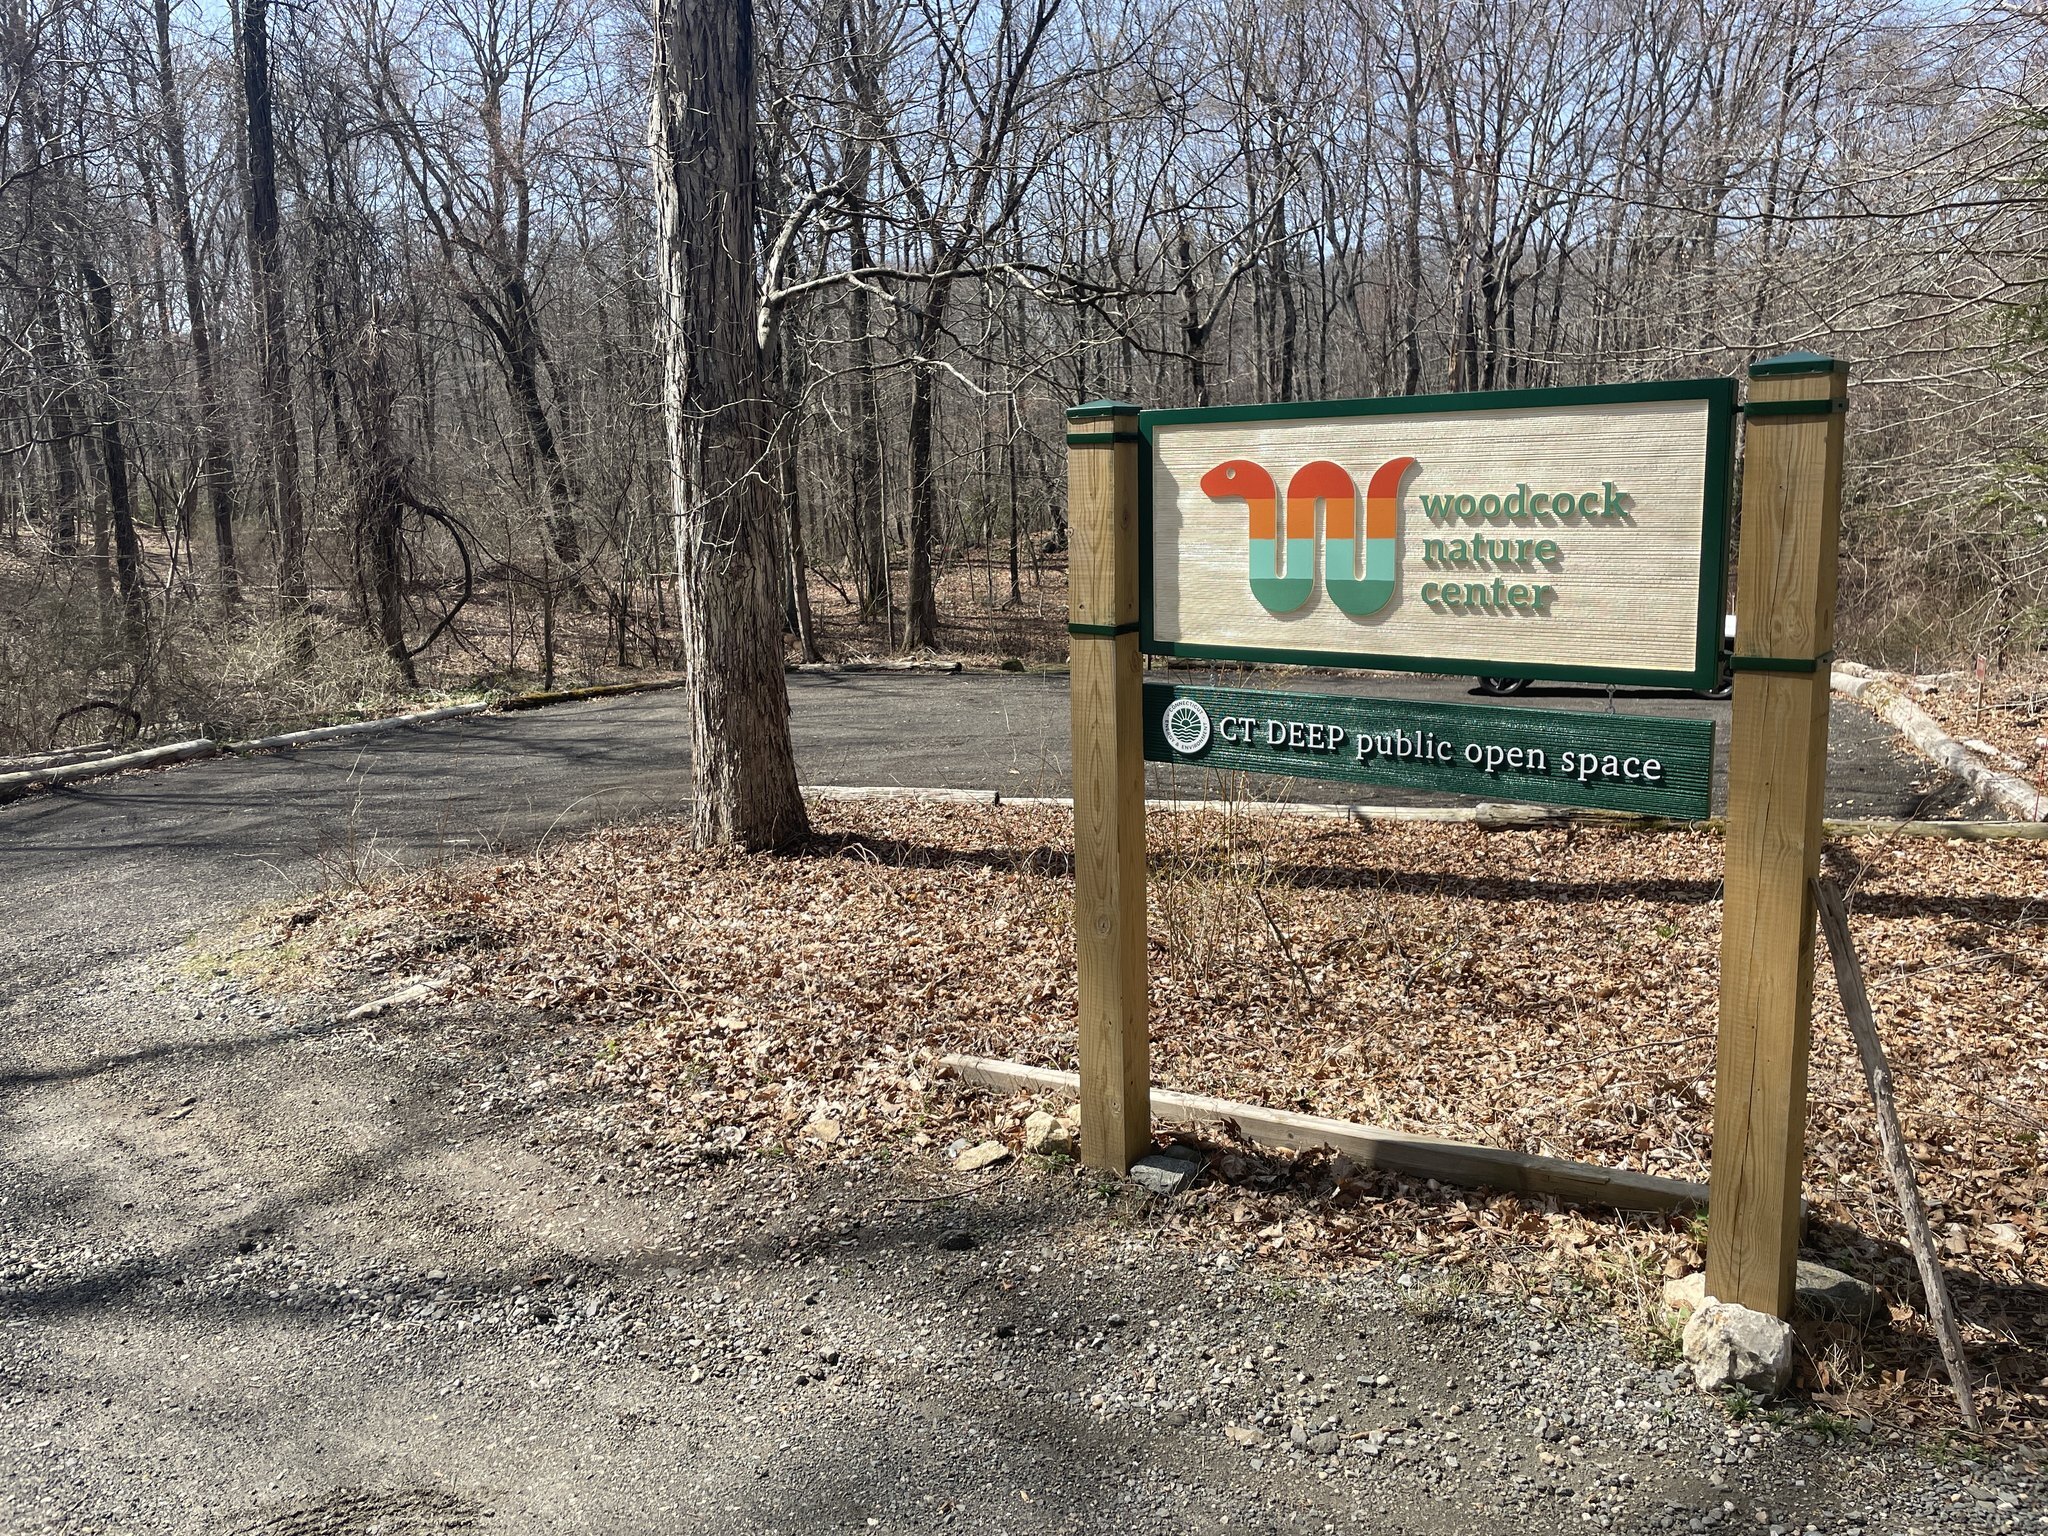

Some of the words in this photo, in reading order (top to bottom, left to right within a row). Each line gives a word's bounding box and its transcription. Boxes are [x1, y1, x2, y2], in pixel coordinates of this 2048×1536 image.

[1419, 481, 1629, 518] woodcock
[1422, 532, 1558, 563] nature
[1420, 577, 1550, 609] center
[1169, 701, 1203, 714] CONNECTICUT
[1219, 716, 1256, 742] CT
[1267, 719, 1345, 750] DEEP
[1355, 729, 1452, 760] public
[1464, 743, 1547, 772] open
[1561, 751, 1662, 782] space
